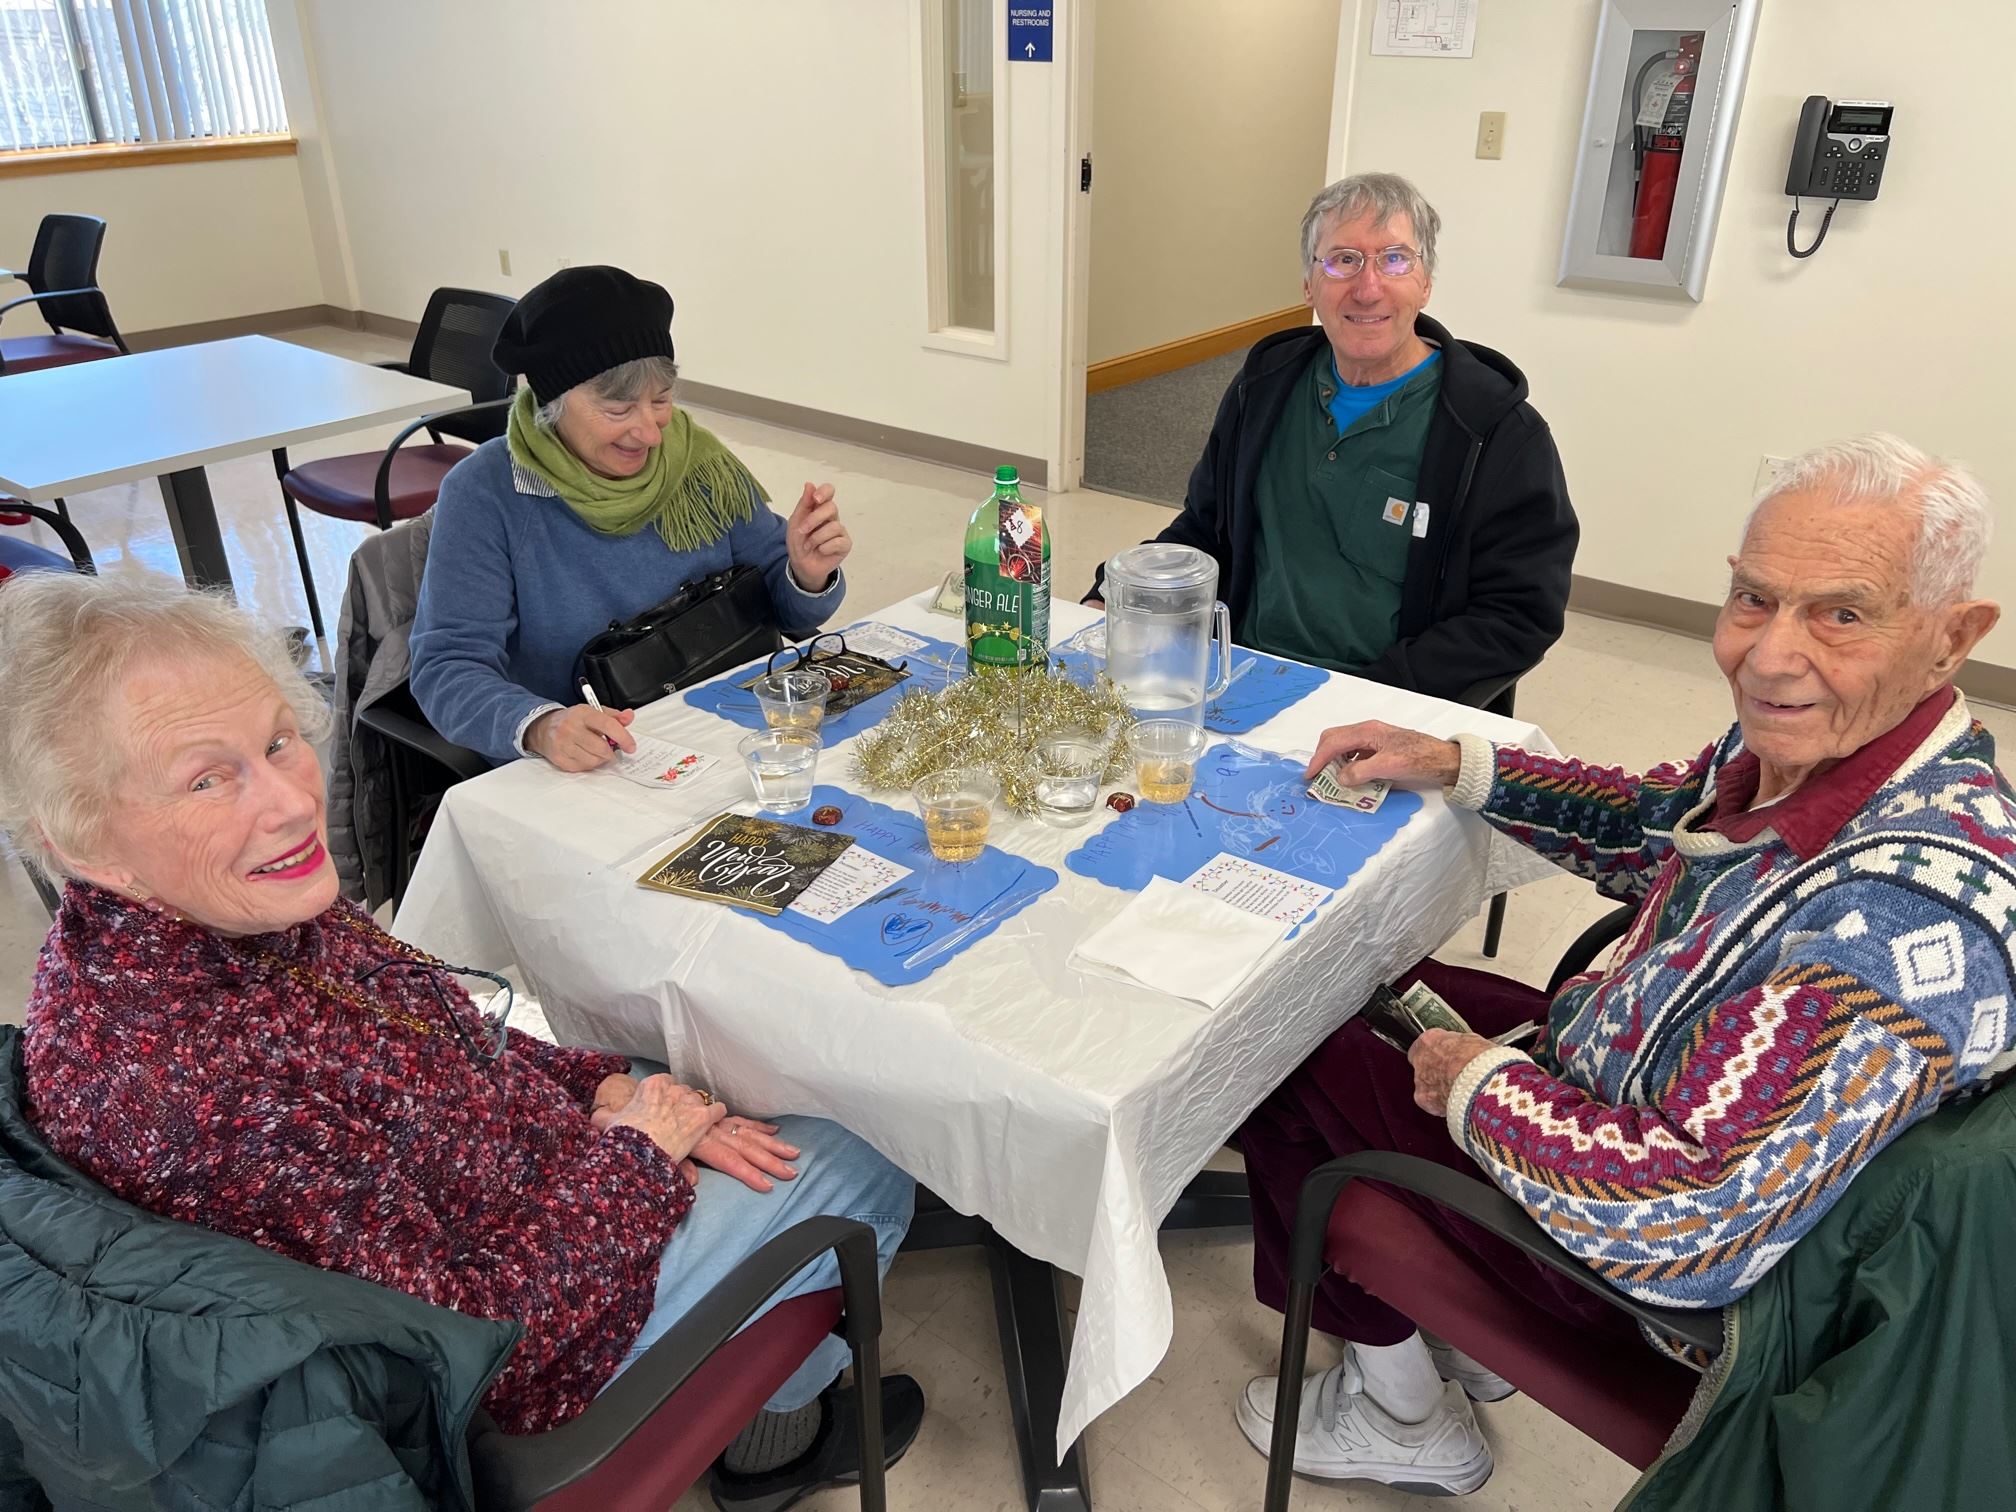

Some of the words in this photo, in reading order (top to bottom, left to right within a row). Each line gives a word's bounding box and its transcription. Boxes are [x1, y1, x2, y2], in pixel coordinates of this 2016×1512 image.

[1010, 9, 1037, 17] NURSING
[1038, 9, 1051, 17] AND
[996, 592, 1020, 613] ALE
[1355, 796, 1378, 810] 5
[729, 832, 772, 848] HAPPY
[853, 819, 904, 847] HAPPY
[699, 840, 785, 882] New
